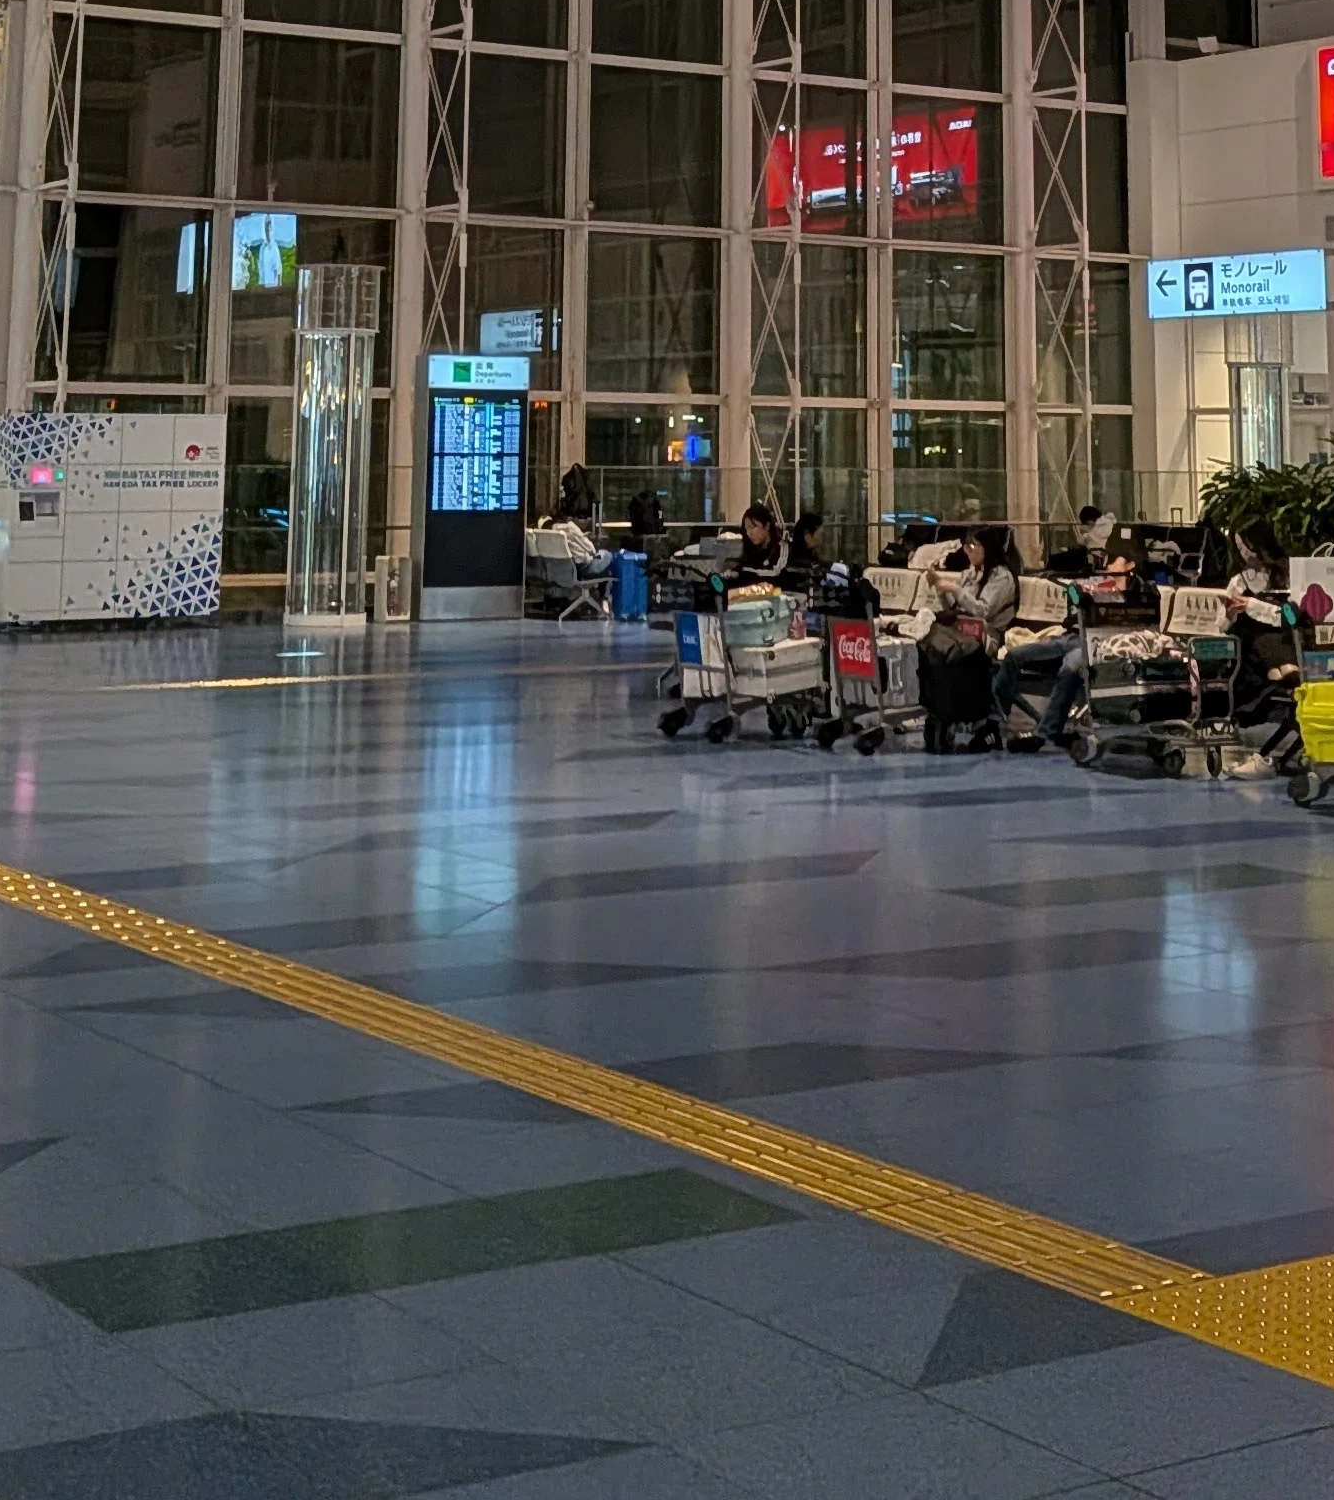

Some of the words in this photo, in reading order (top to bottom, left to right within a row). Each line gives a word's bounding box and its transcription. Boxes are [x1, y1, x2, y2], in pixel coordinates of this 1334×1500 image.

[1220, 259, 1288, 279] モノレール
[1221, 279, 1270, 294] Monorail
